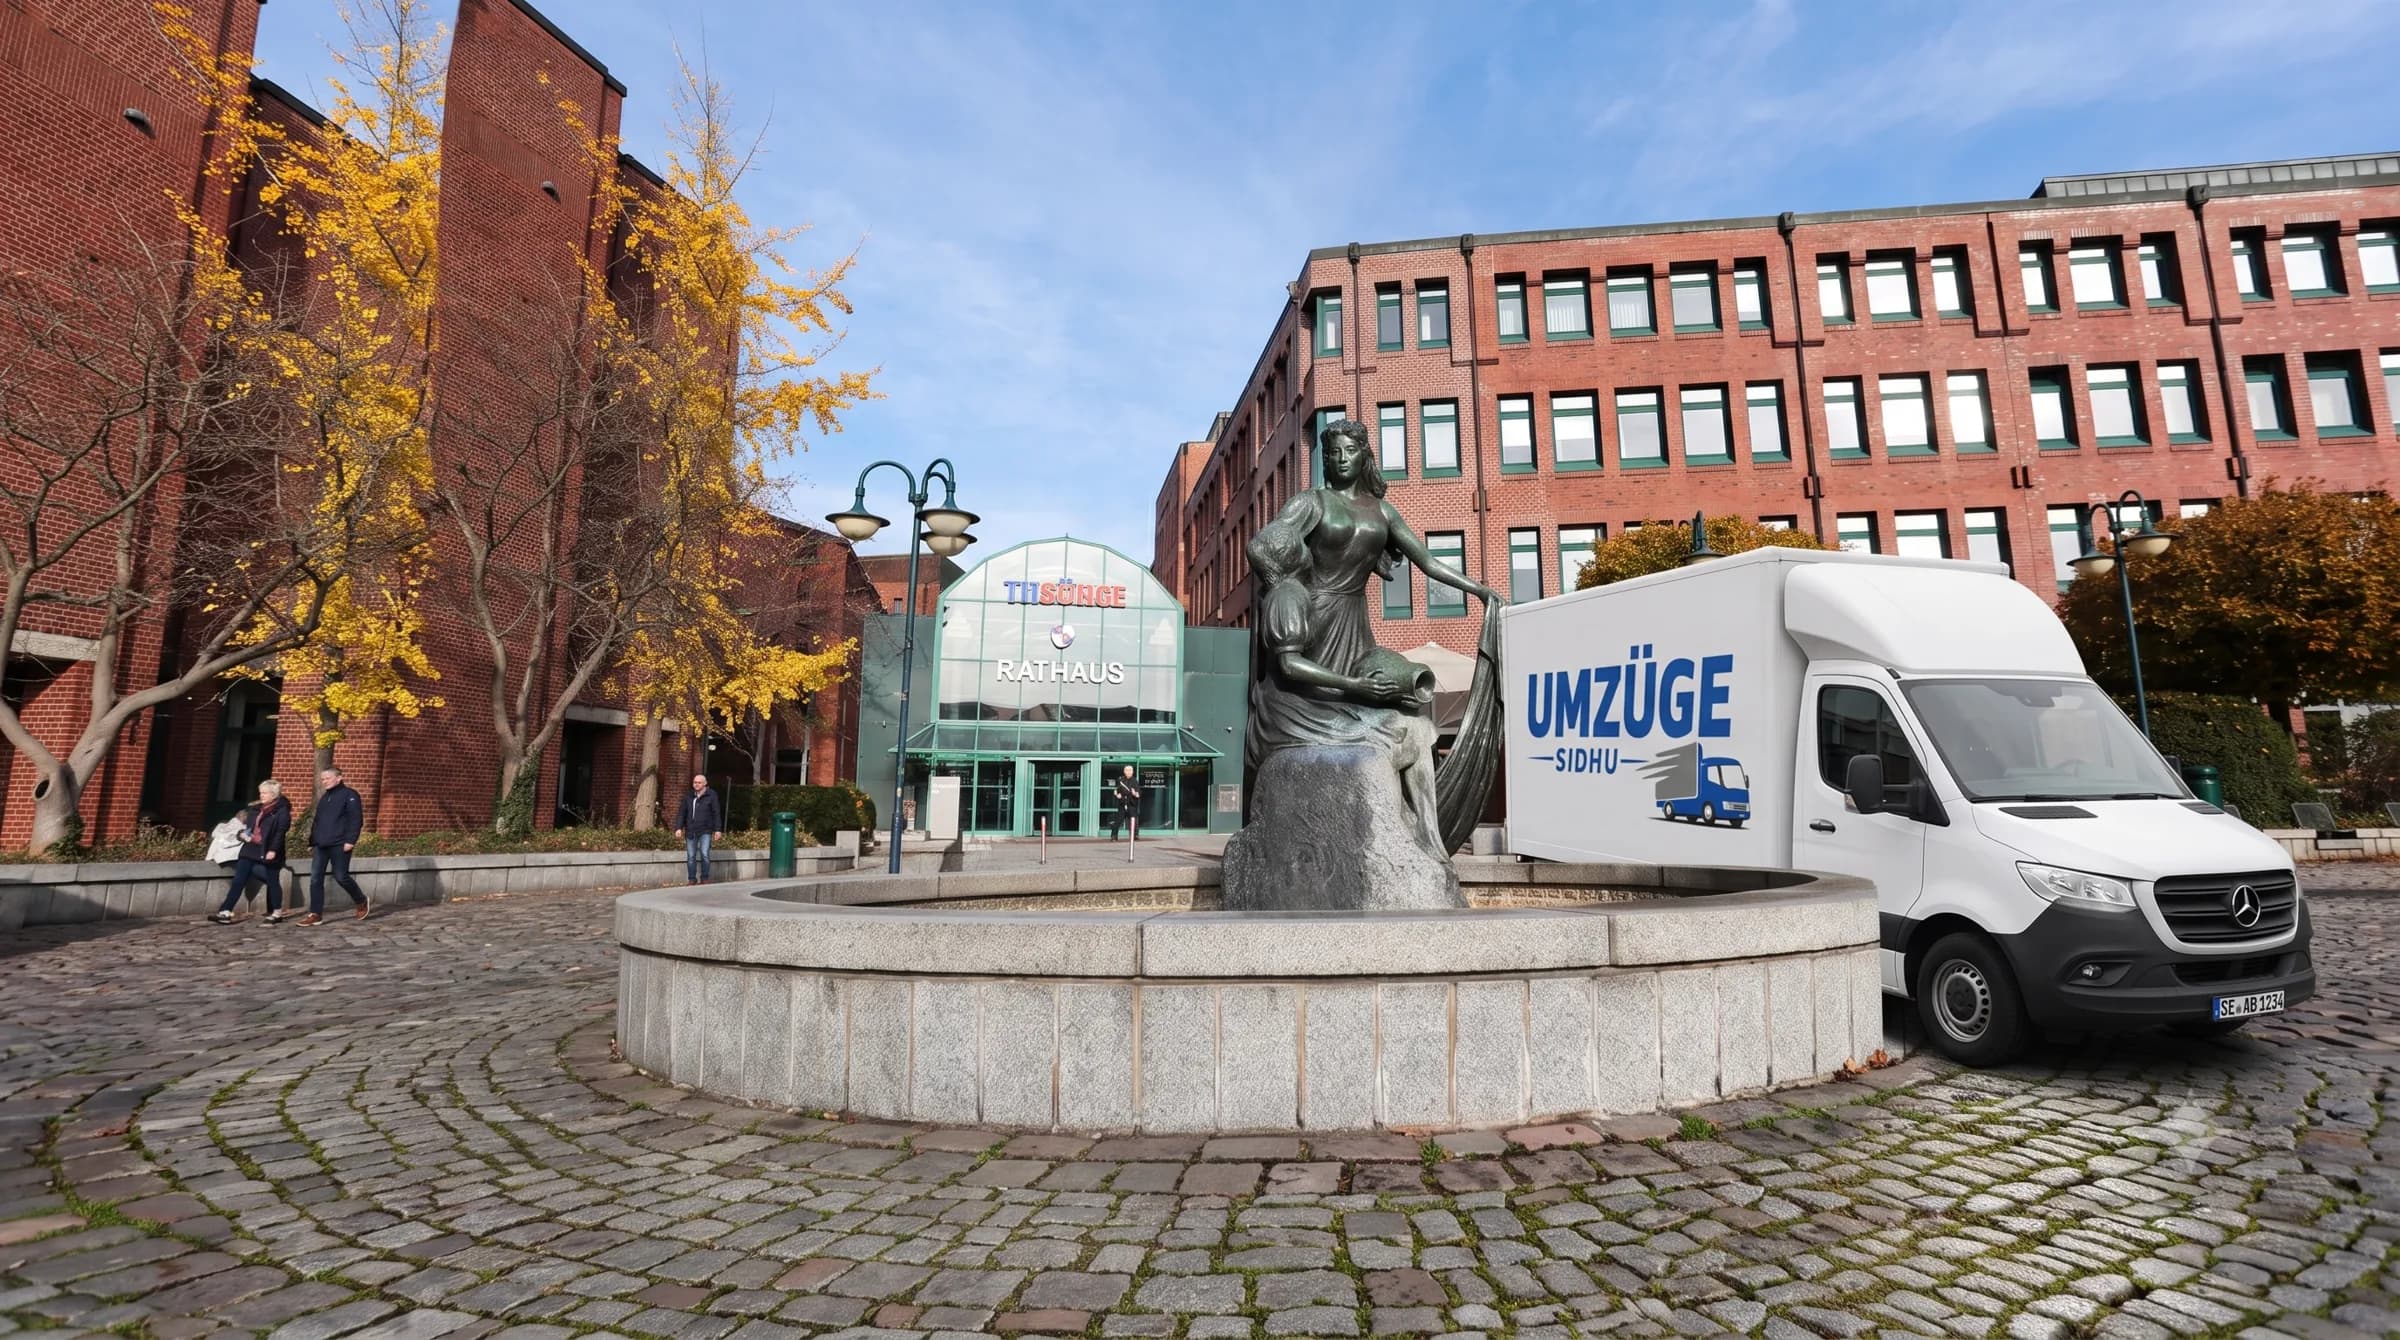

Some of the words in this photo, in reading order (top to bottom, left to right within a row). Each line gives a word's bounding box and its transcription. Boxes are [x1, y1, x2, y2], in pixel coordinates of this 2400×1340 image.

[996, 659, 1125, 684] RATHAUS
[1528, 644, 1734, 738] UMZÜGE
[1556, 748, 1618, 774] SIDHU
[2221, 999, 2235, 1016] SE
[2243, 996, 2257, 1013] AB
[2259, 992, 2283, 1011] 1234
